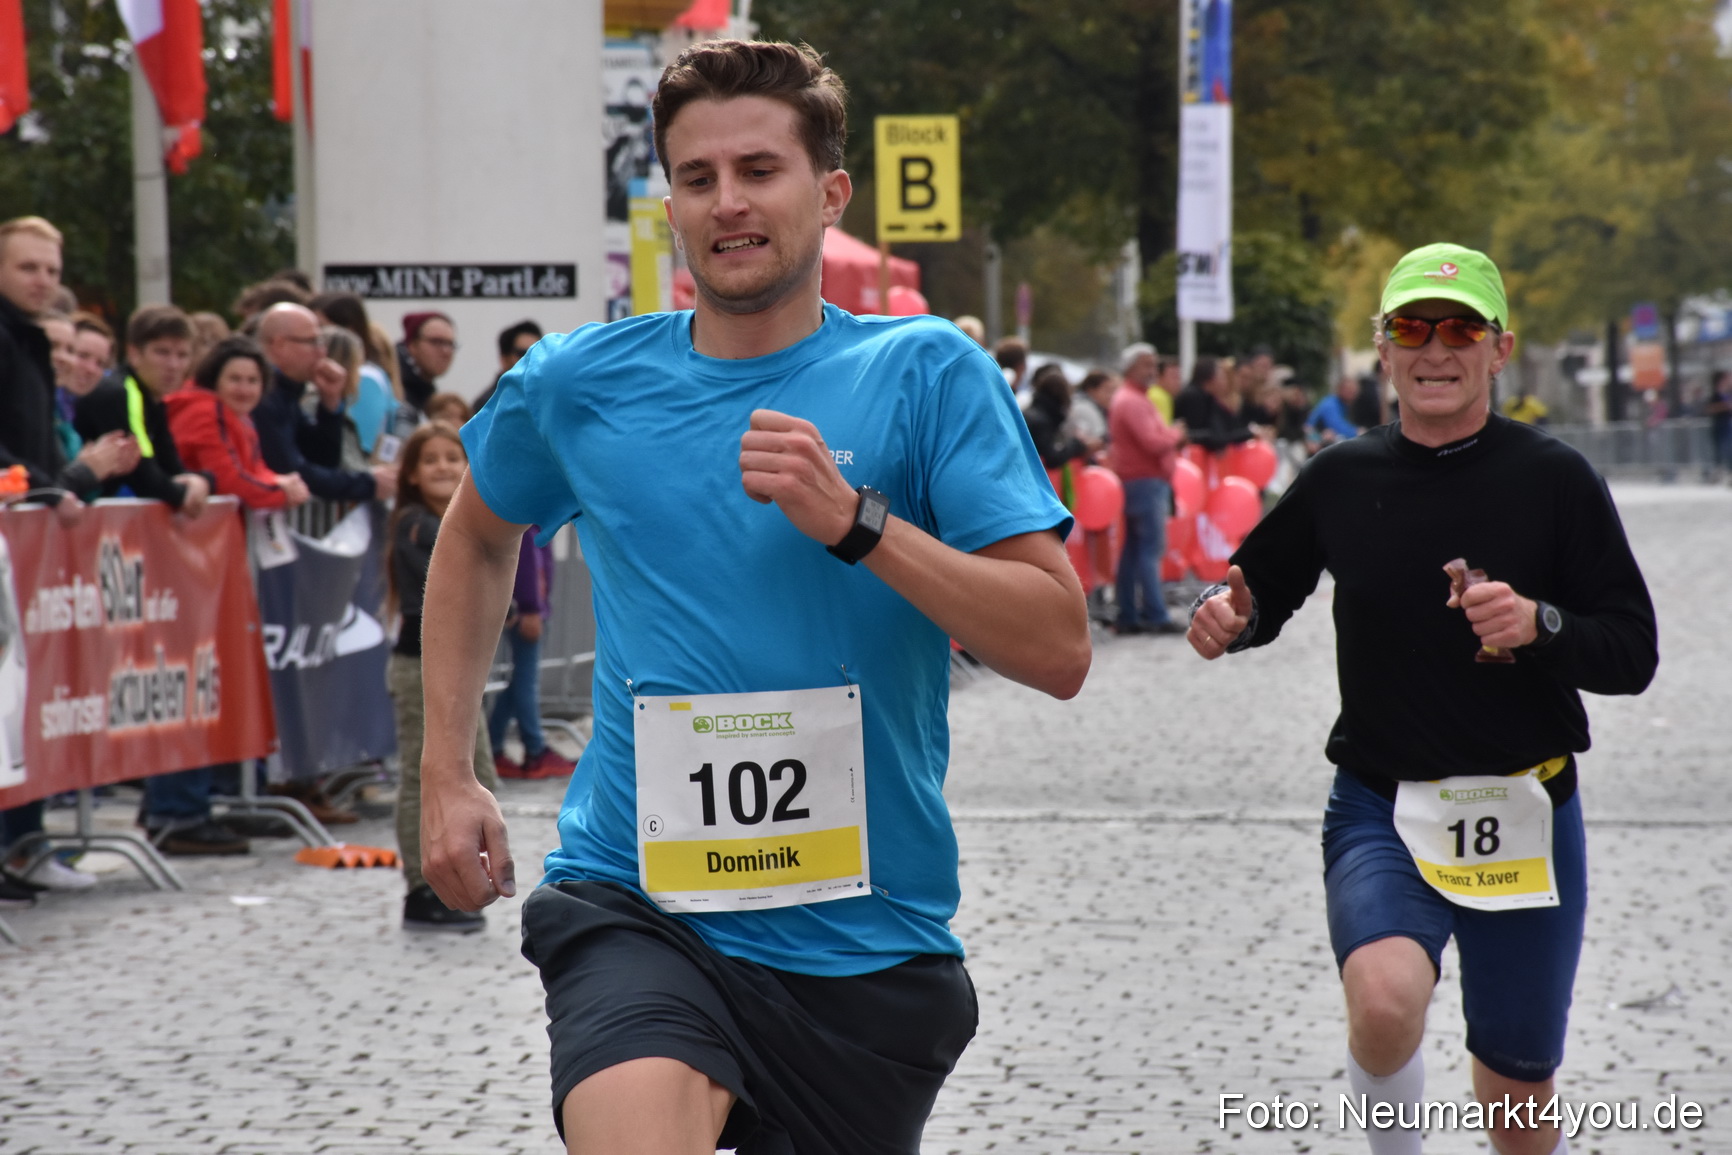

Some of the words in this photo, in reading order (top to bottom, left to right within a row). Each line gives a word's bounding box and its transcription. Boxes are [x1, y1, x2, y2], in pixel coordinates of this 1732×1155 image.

[885, 121, 950, 145] Block
[899, 156, 938, 211] B
[716, 711, 795, 732] BOCK
[741, 732, 749, 740] by
[768, 730, 796, 738] concepts
[689, 758, 810, 827] 102
[1454, 787, 1508, 802] BOCK
[649, 820, 657, 833] C
[1447, 816, 1501, 858] 18
[706, 846, 801, 874] Dominik
[1436, 869, 1473, 888] Franz
[1475, 869, 1520, 888] Xaver
